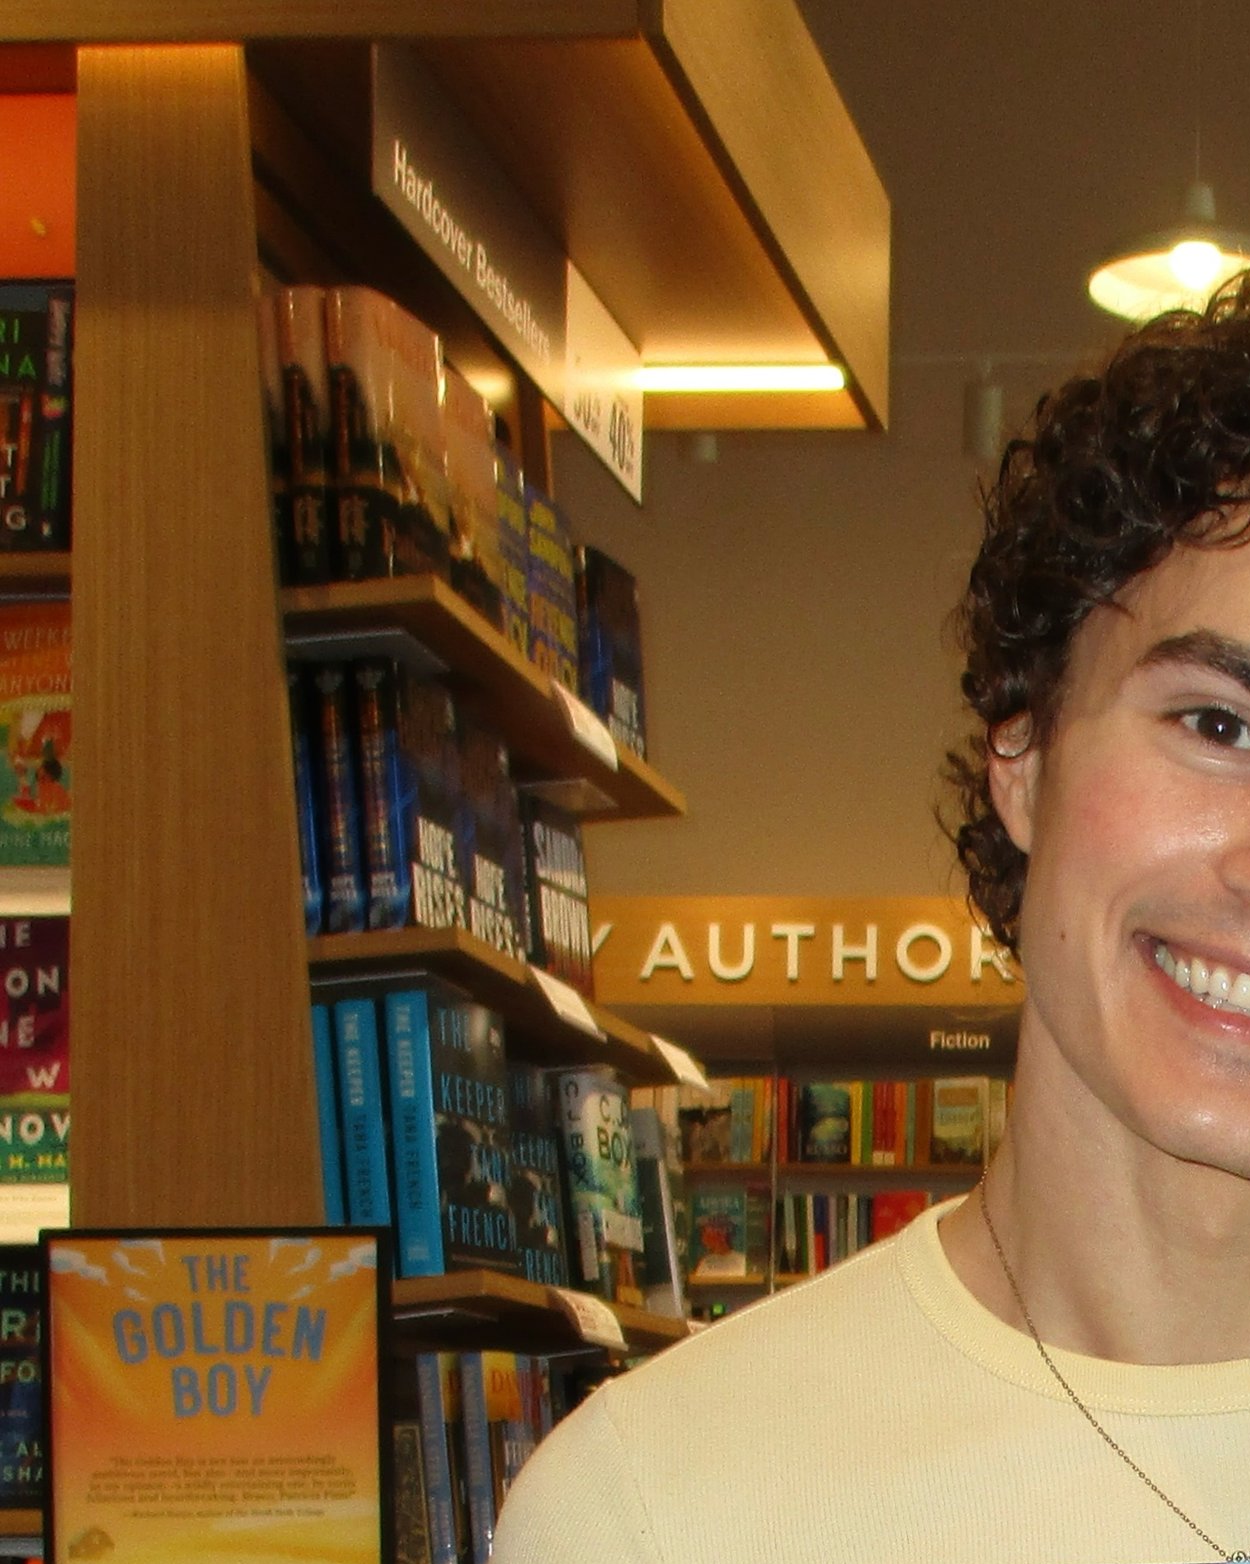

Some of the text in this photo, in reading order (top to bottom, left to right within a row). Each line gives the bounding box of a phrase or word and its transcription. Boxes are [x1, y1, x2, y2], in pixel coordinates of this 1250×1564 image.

[394, 139, 551, 356] Hardcover Bestsellers
[638, 922, 1018, 983] AUTHOR
[929, 1030, 991, 1050] Fiction
[181, 1254, 251, 1293] THE
[112, 1300, 327, 1365] GOLDEN
[171, 1363, 273, 1418] BOY
